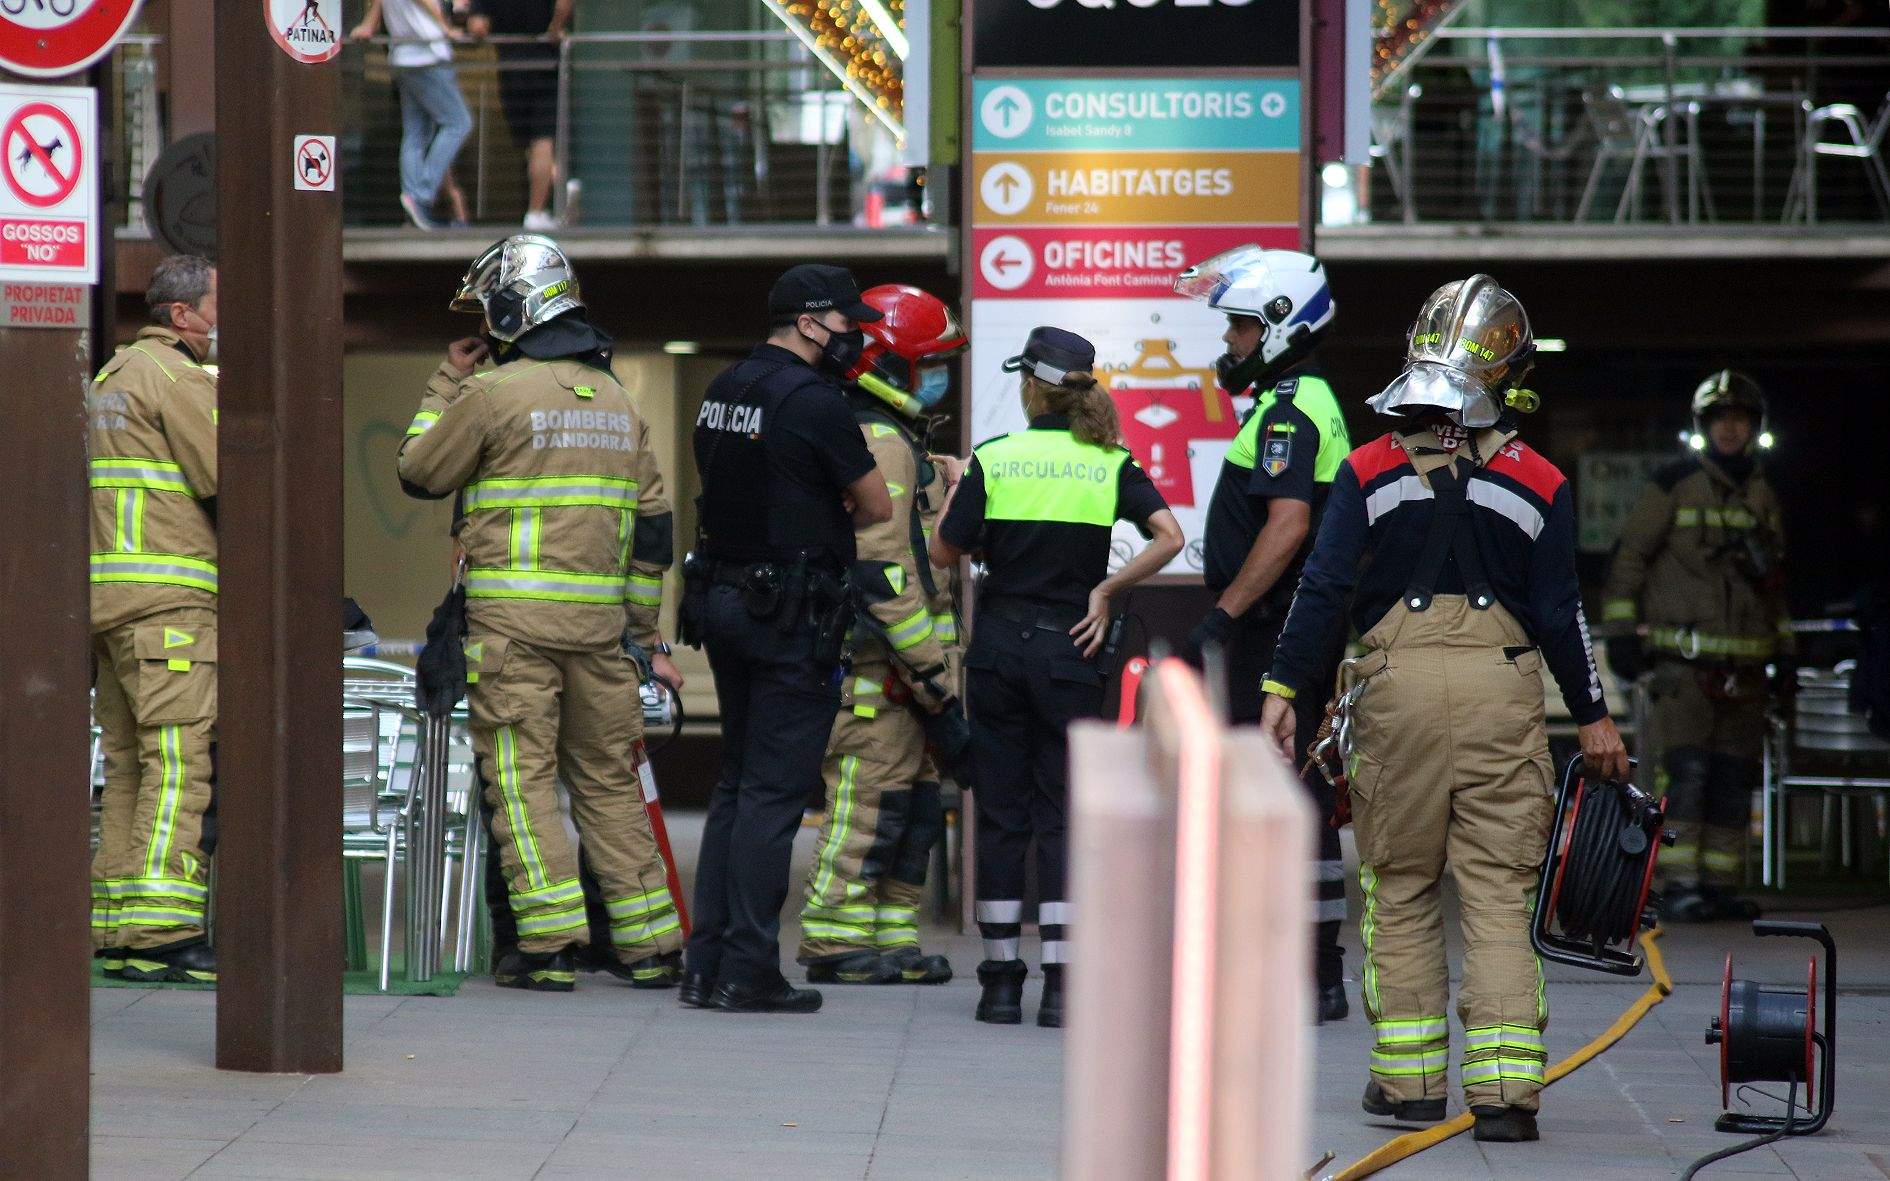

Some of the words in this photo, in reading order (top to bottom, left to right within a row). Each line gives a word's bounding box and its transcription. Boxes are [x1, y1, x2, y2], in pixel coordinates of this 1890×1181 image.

[286, 27, 336, 43] PATINAR
[1045, 92, 1253, 119] CONSULTORIS
[1046, 125, 1082, 136] Isabel
[1085, 125, 1121, 138] Sandy
[1124, 125, 1133, 136] 8
[1048, 169, 1233, 196] HABITATGES
[1046, 203, 1080, 214] Fener
[2, 224, 79, 243] GOSSOS
[1043, 240, 1186, 269] OFICINES
[1094, 274, 1121, 286] Font
[1124, 274, 1173, 286] Caminal
[4, 285, 83, 305] PROPIETAT
[805, 300, 833, 309] POLICIA
[10, 305, 76, 324] PRIVADA
[1479, 347, 1496, 361] 147
[530, 409, 631, 433] BOMBERS
[696, 400, 763, 434] POLICIA
